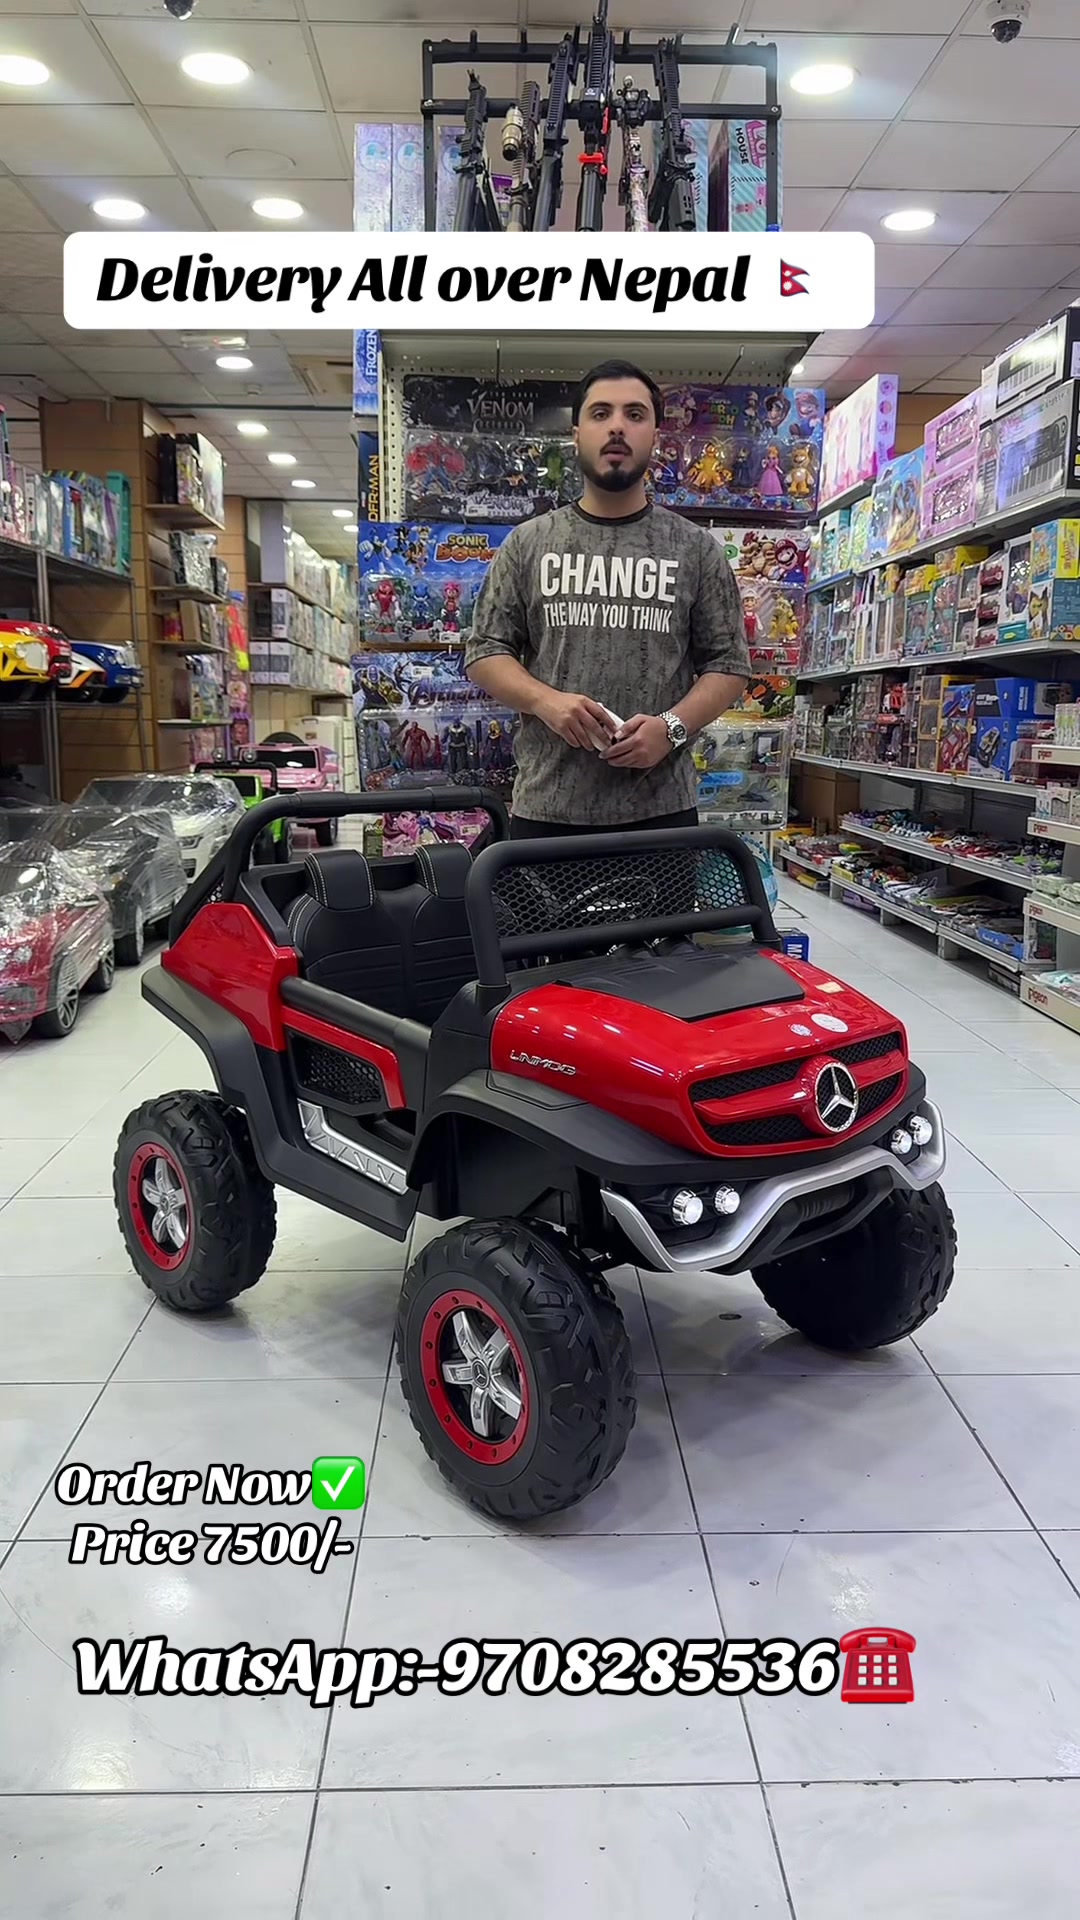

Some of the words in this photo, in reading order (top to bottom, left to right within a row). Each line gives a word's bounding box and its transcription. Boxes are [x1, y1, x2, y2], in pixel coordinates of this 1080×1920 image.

[735, 128, 749, 165] HOUSE
[366, 330, 378, 376] FROZEN
[467, 390, 534, 423] VENOM
[368, 455, 379, 522] DER-MAN
[436, 544, 497, 561] BOOM
[447, 535, 488, 546] SONIC
[540, 552, 679, 603] CHANGE
[601, 604, 629, 629] YOU
[632, 606, 673, 633] THINK
